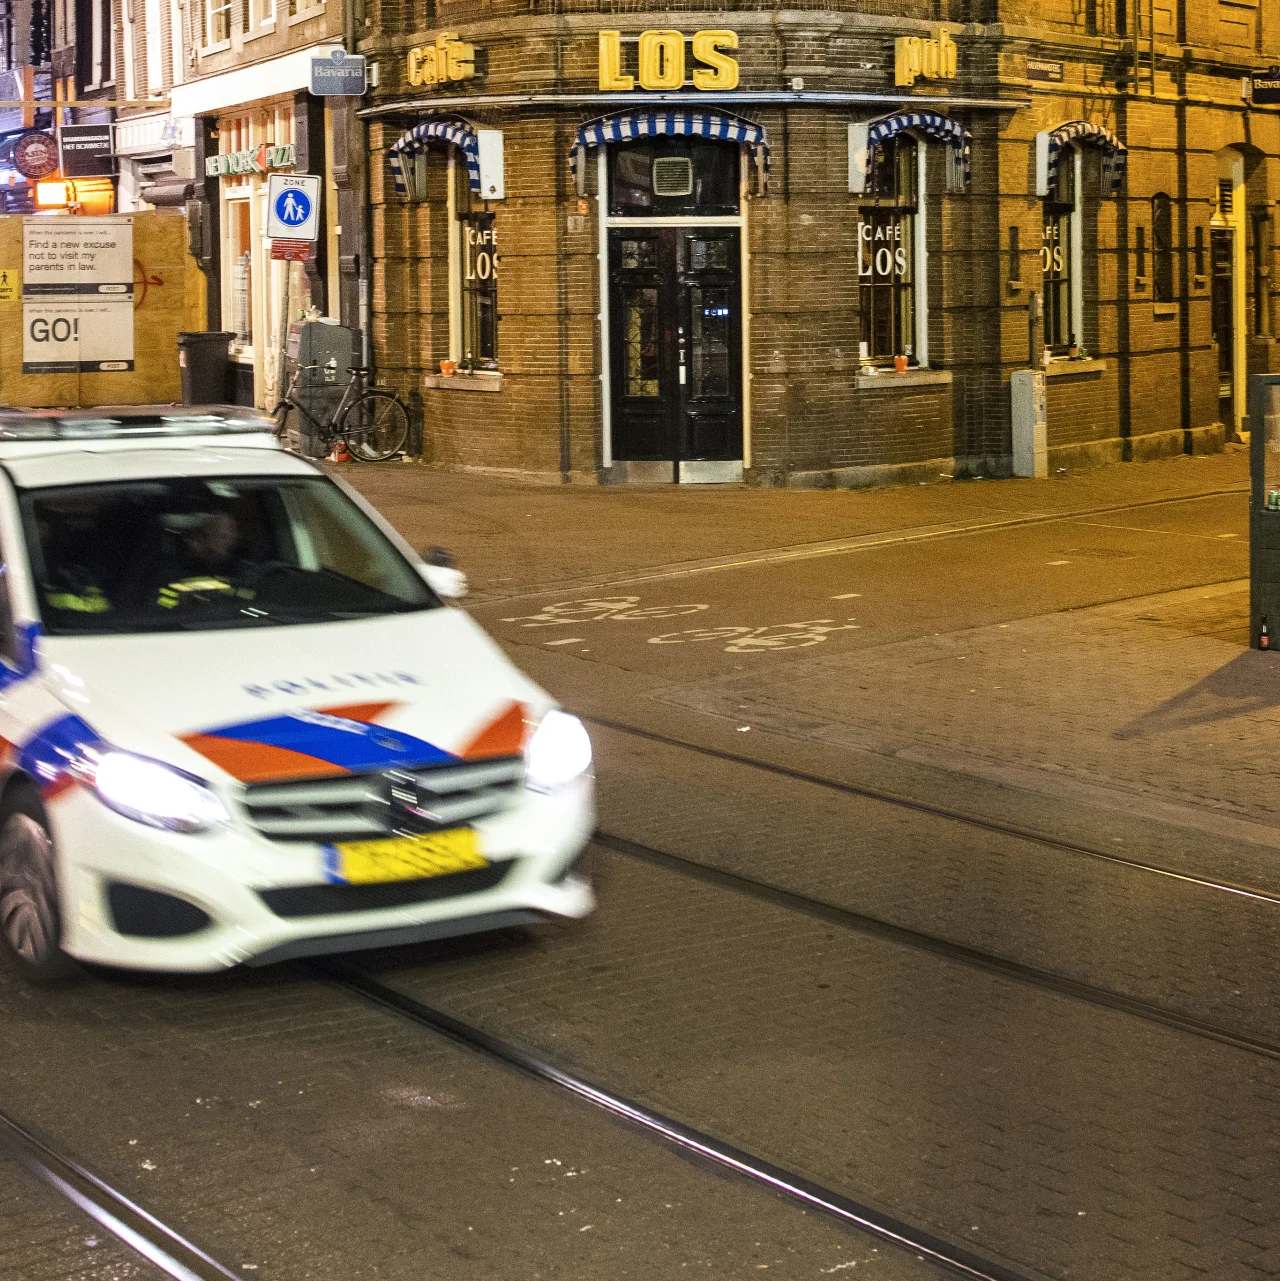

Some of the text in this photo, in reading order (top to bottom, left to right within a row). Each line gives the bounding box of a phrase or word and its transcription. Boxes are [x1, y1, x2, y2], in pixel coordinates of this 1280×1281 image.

[407, 32, 474, 86] café
[599, 30, 739, 91] LOS
[895, 28, 956, 86] pub
[314, 65, 362, 77] Bavaria
[469, 228, 498, 245] CAFÉ
[862, 223, 901, 241] CAFÉ
[28, 239, 117, 249] Find a new excuse
[857, 222, 906, 276] LOS
[28, 251, 96, 261] not to visit my
[1039, 246, 1063, 271] OS
[28, 262, 97, 273] parents in law.
[30, 317, 79, 342] GO!
